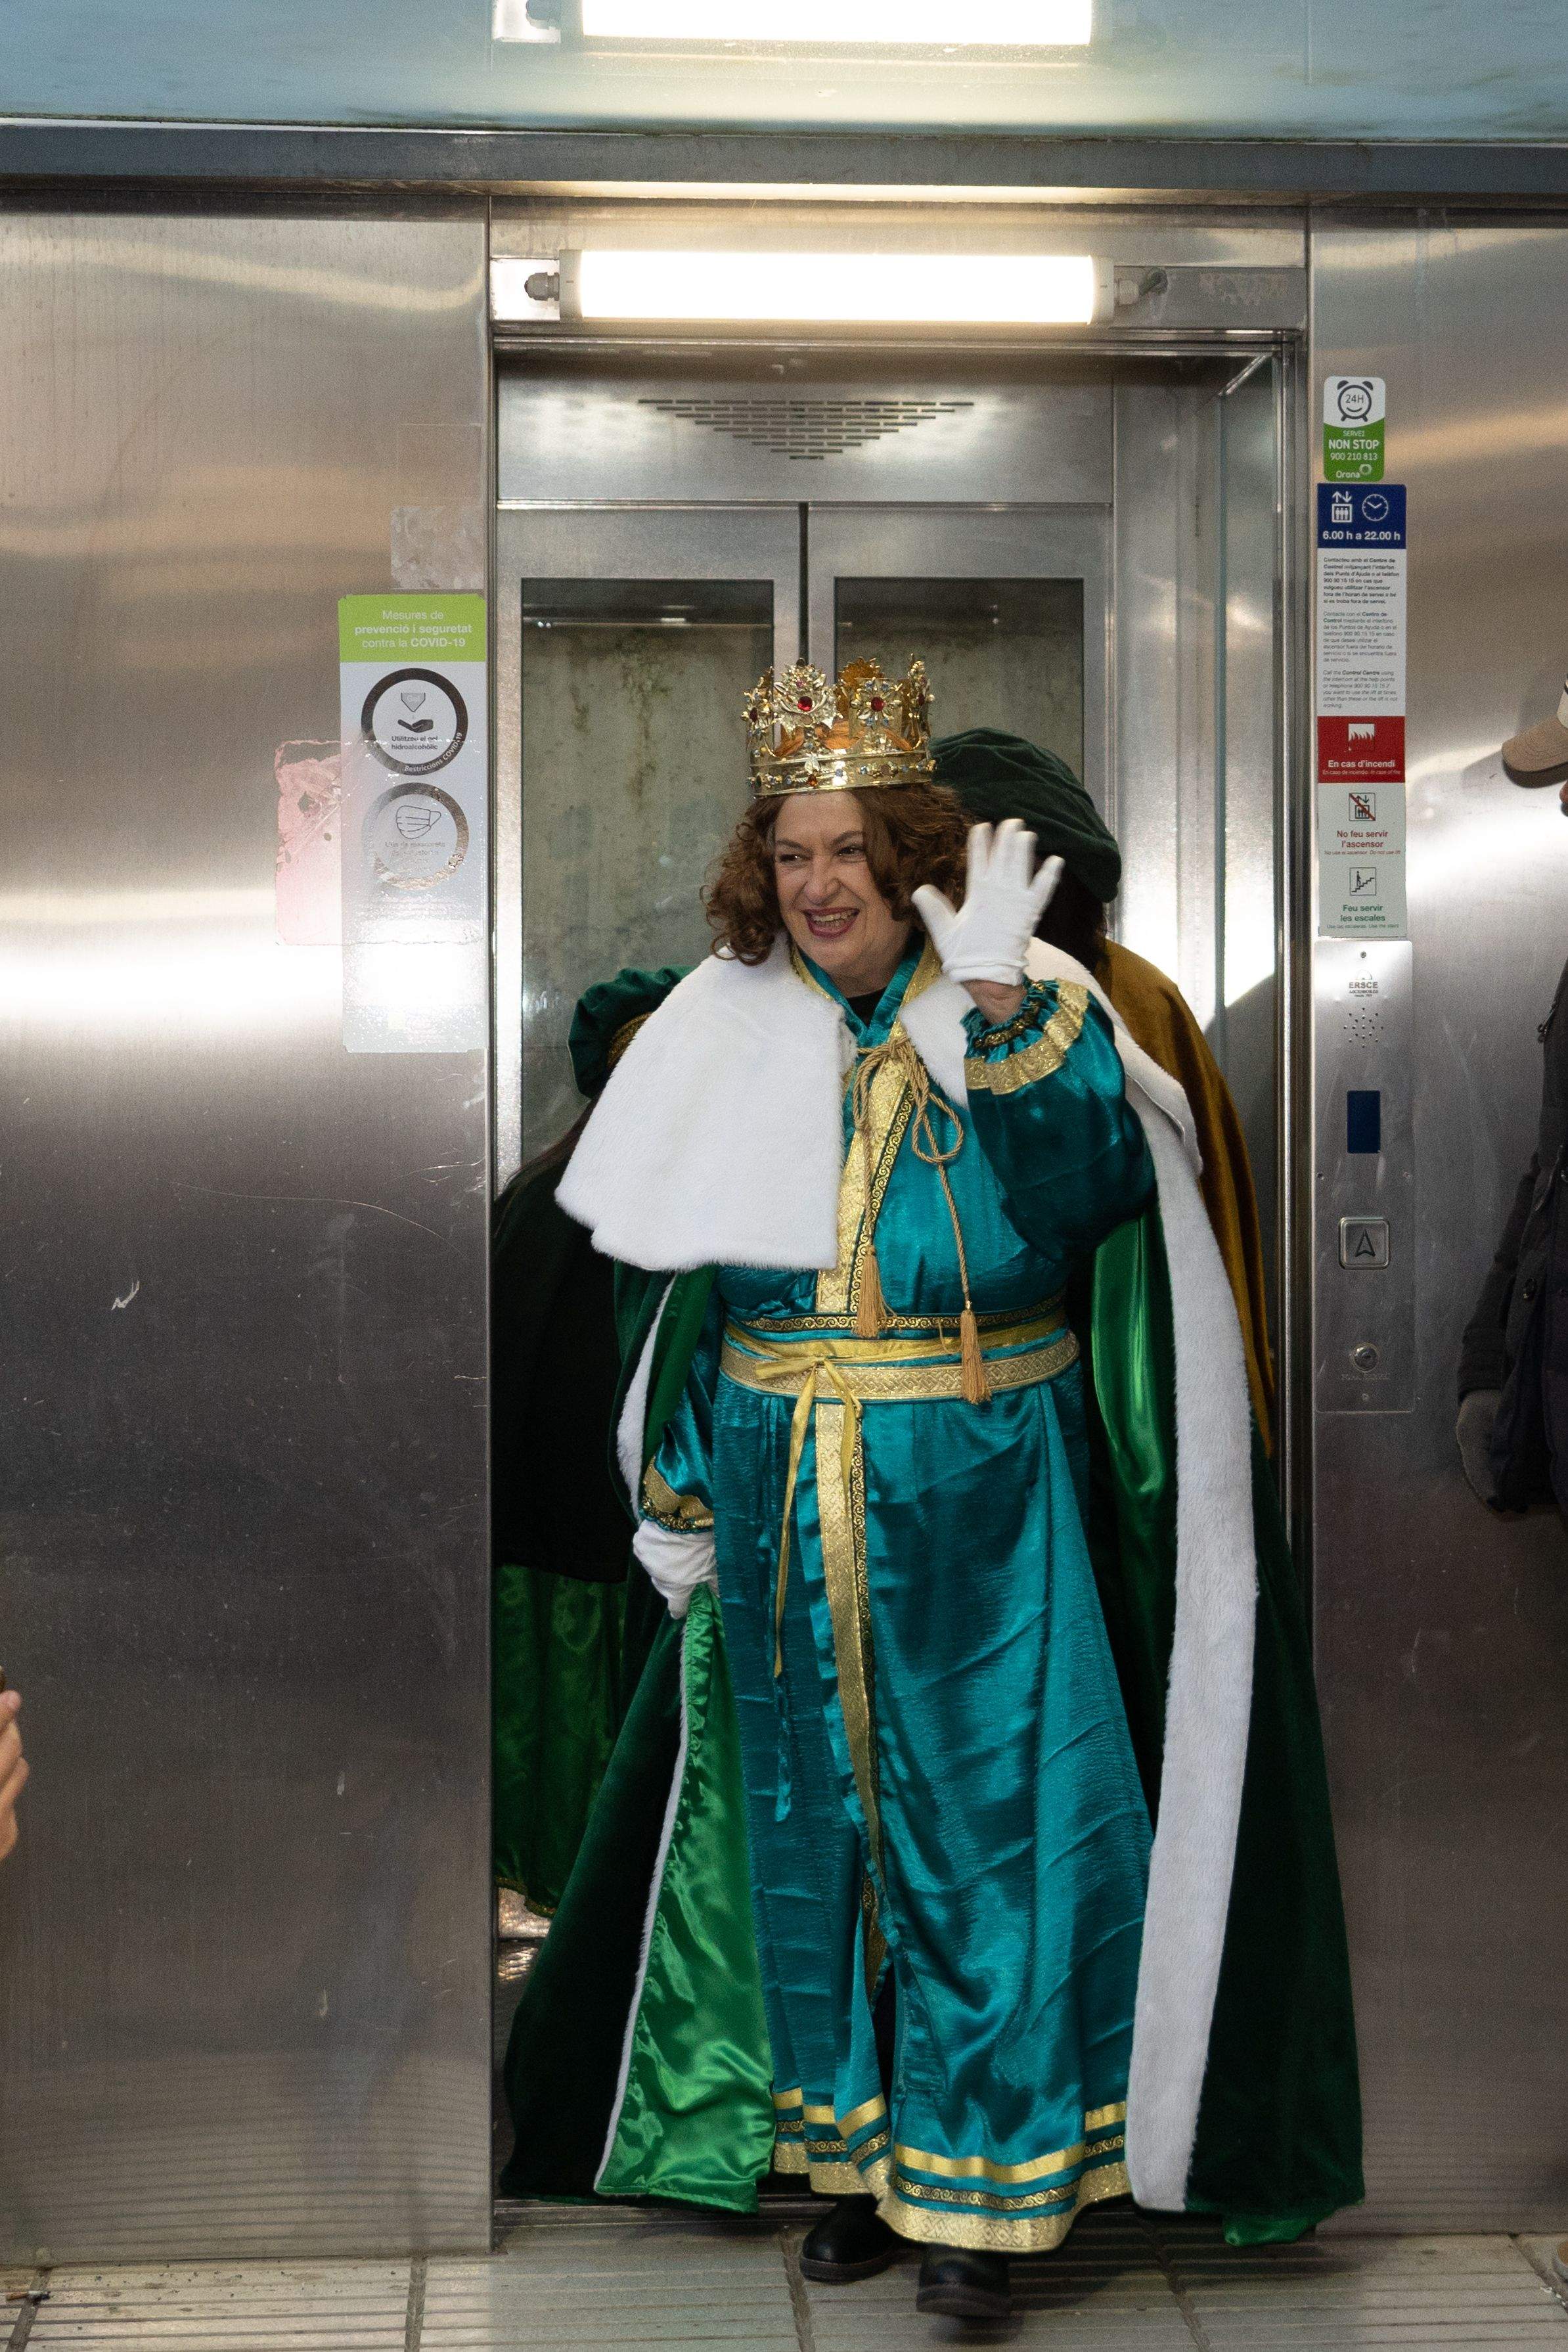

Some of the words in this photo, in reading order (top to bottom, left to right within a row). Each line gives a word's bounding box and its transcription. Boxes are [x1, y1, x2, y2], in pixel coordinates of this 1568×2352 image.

[1345, 394, 1364, 403] 24H
[1328, 439, 1350, 449] NON
[1353, 440, 1379, 449] STOP
[1322, 530, 1343, 539] 6.00
[1346, 531, 1353, 539] h
[1364, 531, 1391, 541] 22.00
[1394, 531, 1400, 541] h
[382, 610, 427, 620] Mesures
[430, 610, 444, 620] de
[354, 625, 410, 636] prevenció
[413, 625, 416, 633] i
[419, 624, 473, 635] seguretat
[362, 639, 395, 648] contra
[399, 638, 407, 647] la
[411, 637, 466, 647] COVID-19
